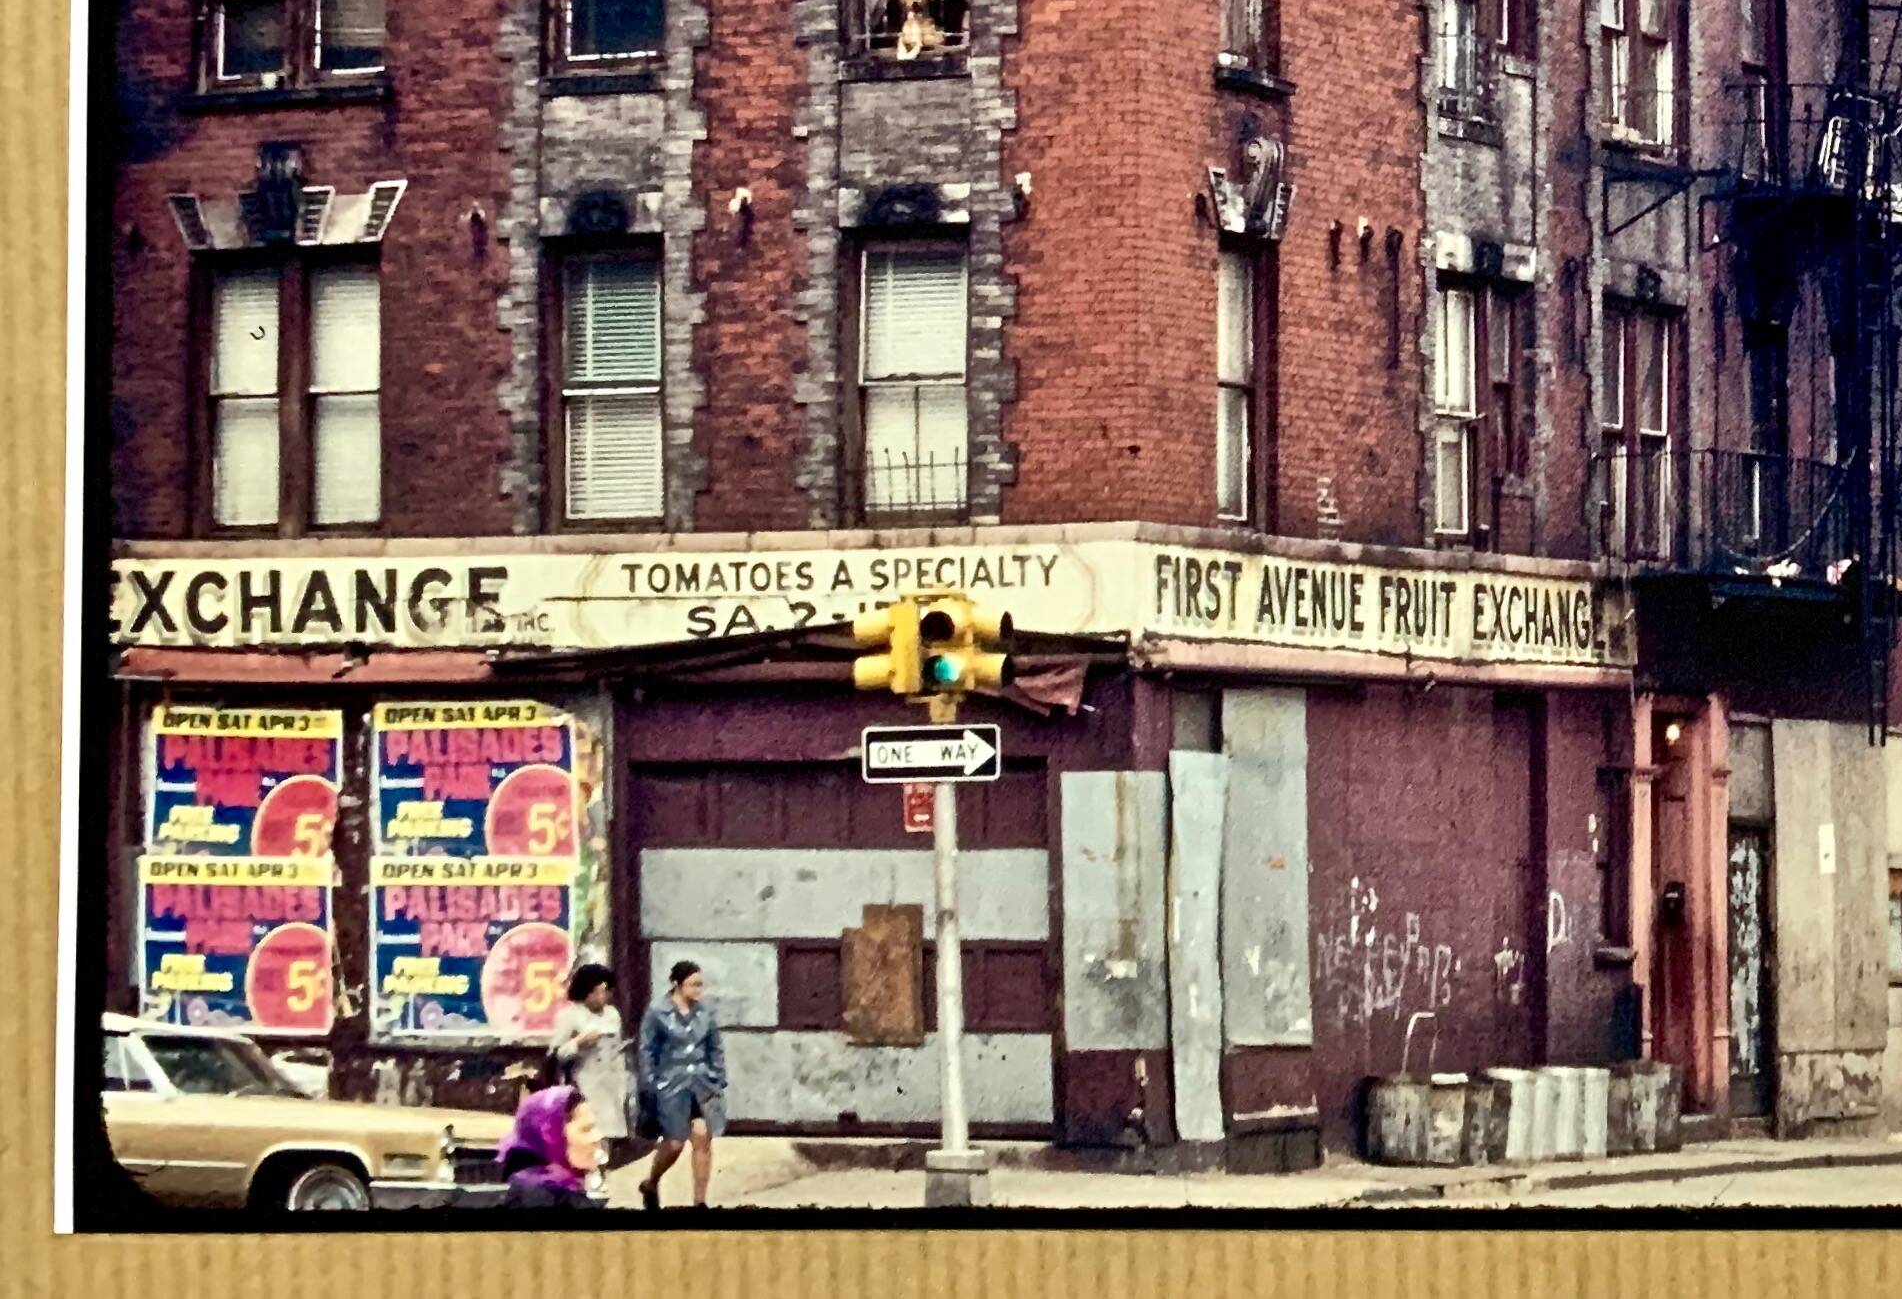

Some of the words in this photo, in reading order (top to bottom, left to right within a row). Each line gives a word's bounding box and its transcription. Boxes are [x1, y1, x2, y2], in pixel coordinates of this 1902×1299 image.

[621, 560, 815, 593] TOMATOES
[830, 559, 854, 591] A
[869, 554, 1059, 591] SPECIALTY
[1154, 554, 1243, 622] FIRST
[1256, 565, 1366, 632] AVENUE
[1377, 576, 1457, 639] FRUIT
[1472, 583, 1606, 651] EXCHANGE
[384, 707, 435, 723] OPEN
[442, 706, 475, 722] SAT
[483, 706, 520, 721] APR
[877, 745, 913, 764] ONE
[940, 743, 978, 761] WAY
[150, 862, 199, 876] OPEN
[205, 862, 239, 878] SAT
[246, 863, 283, 878] APR
[382, 863, 434, 878] OPEN
[442, 862, 477, 878] SAT
[484, 863, 522, 878] APR
